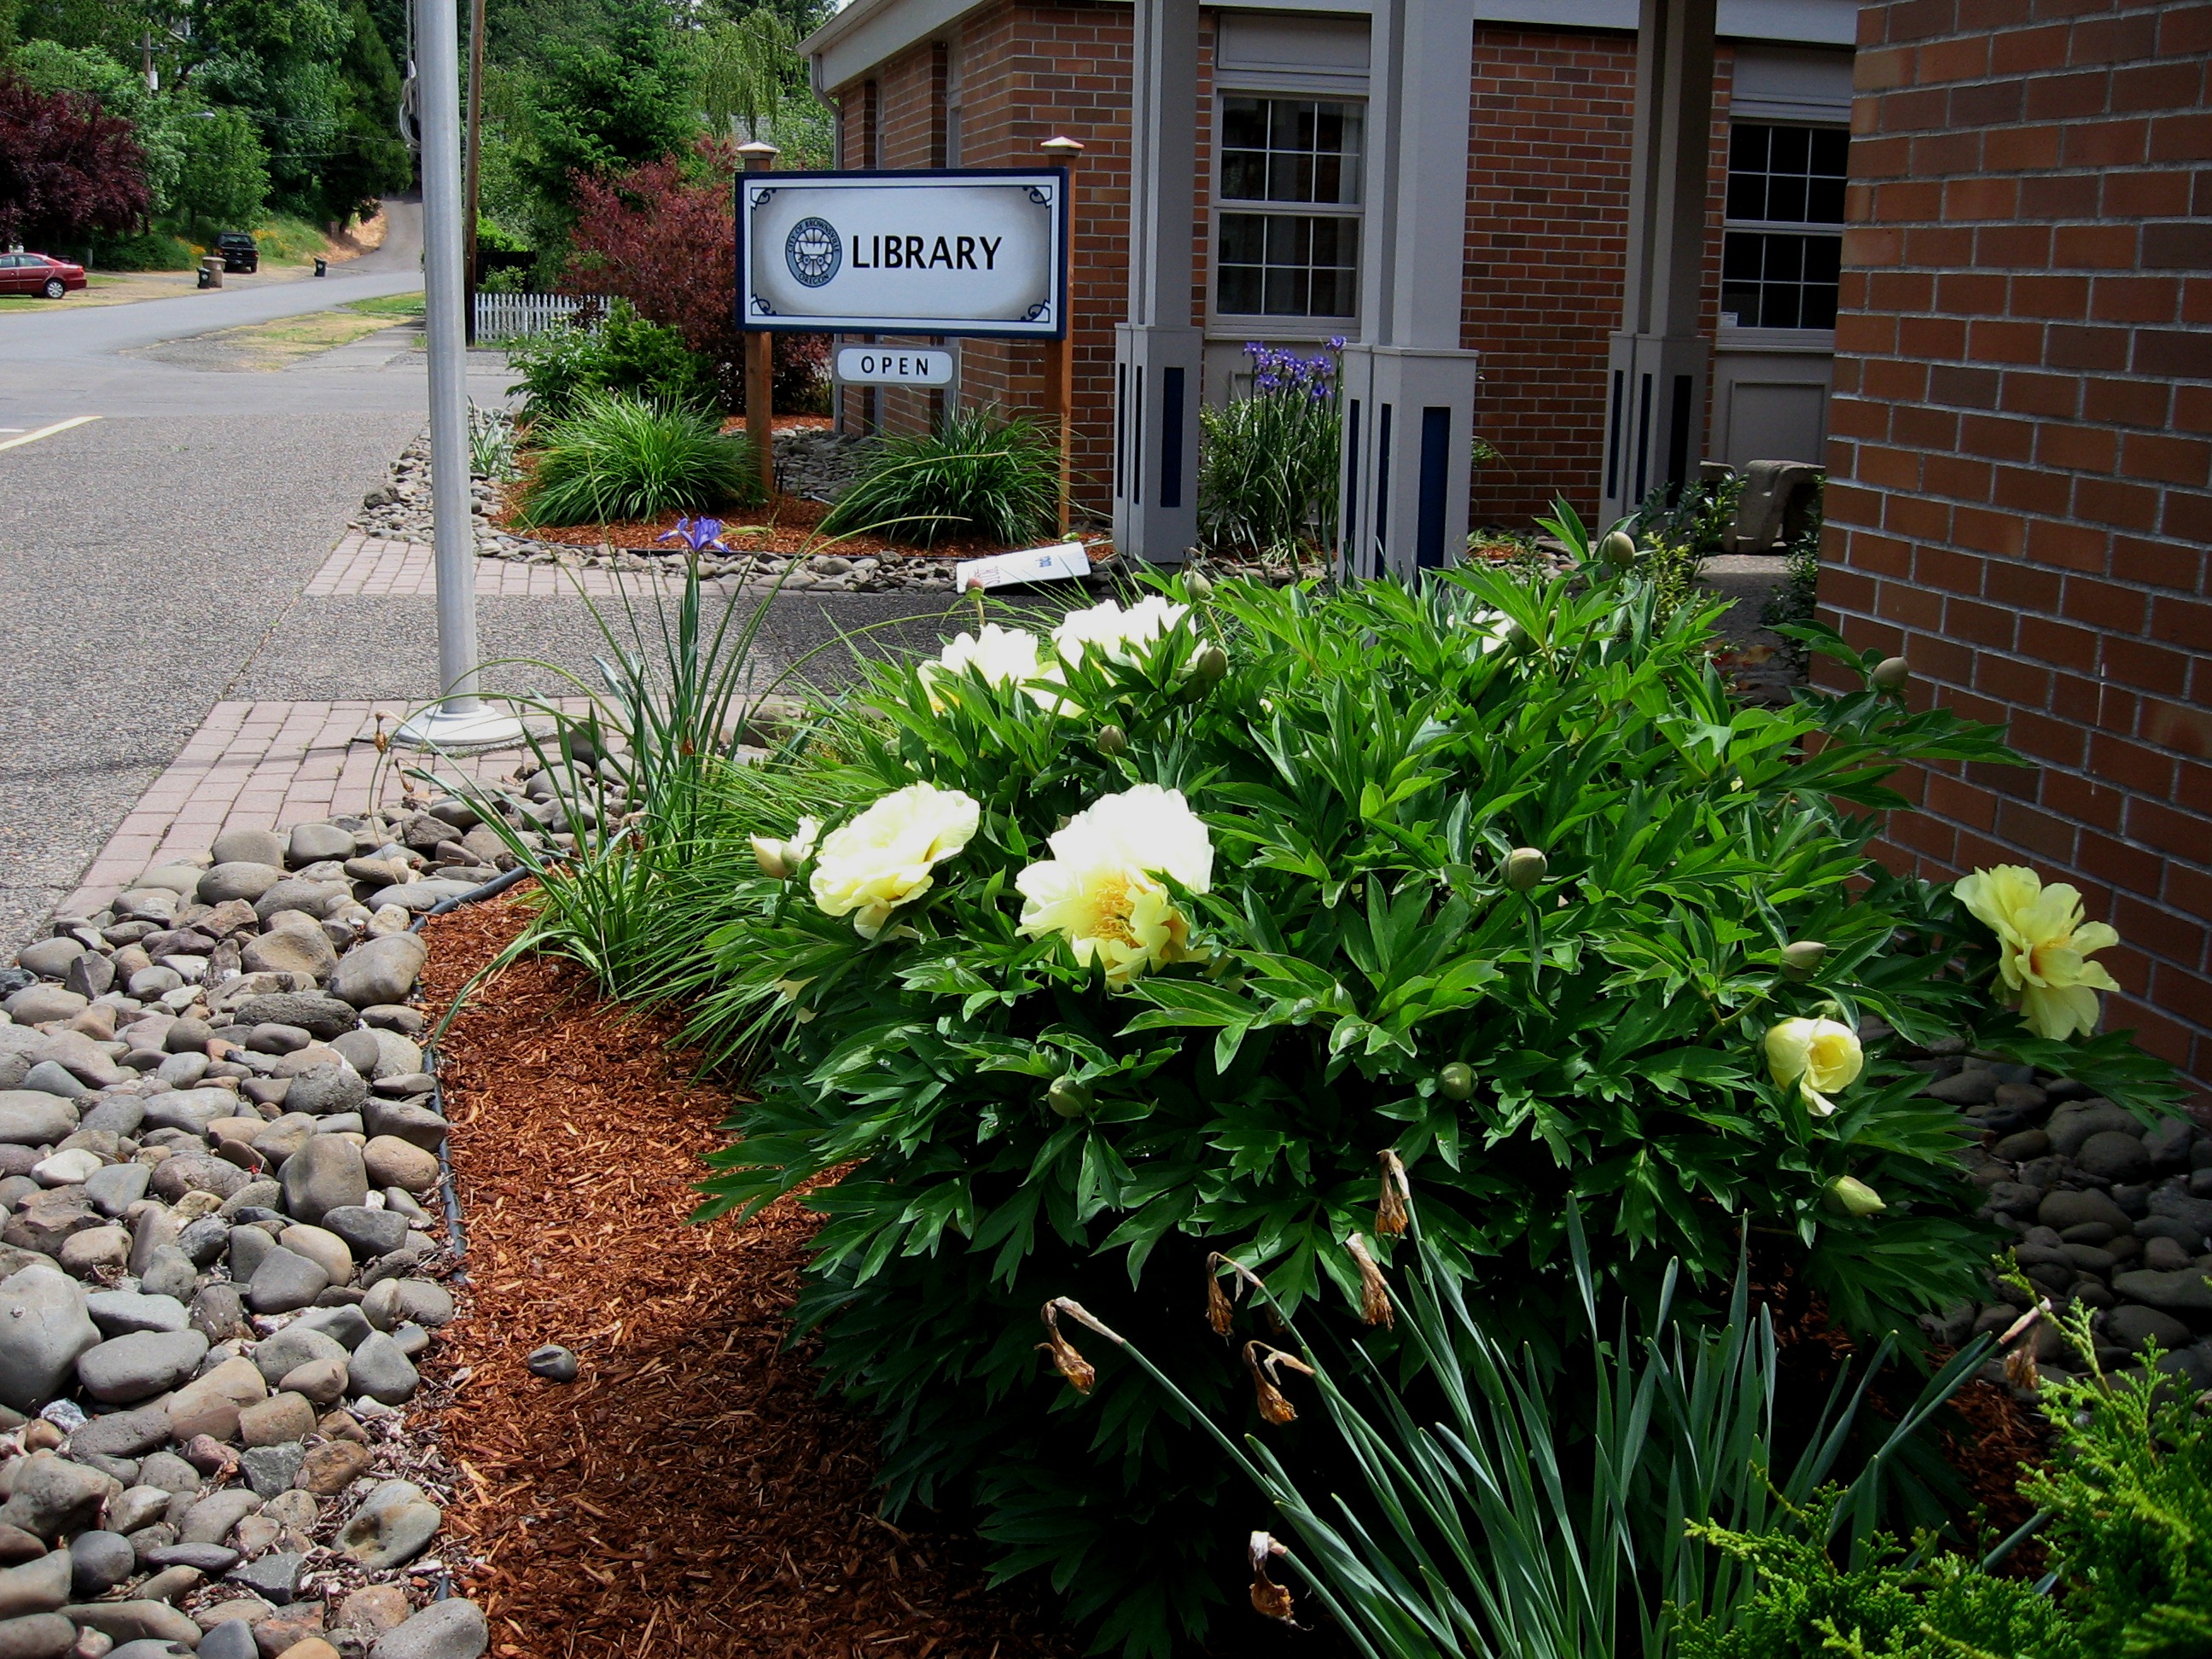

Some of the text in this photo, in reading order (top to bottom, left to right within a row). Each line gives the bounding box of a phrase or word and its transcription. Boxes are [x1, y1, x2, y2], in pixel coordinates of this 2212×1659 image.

[788, 236, 796, 253] CITY
[853, 235, 1003, 271] LIBRARY
[798, 273, 830, 285] OREGON
[860, 355, 929, 376] OPEN
